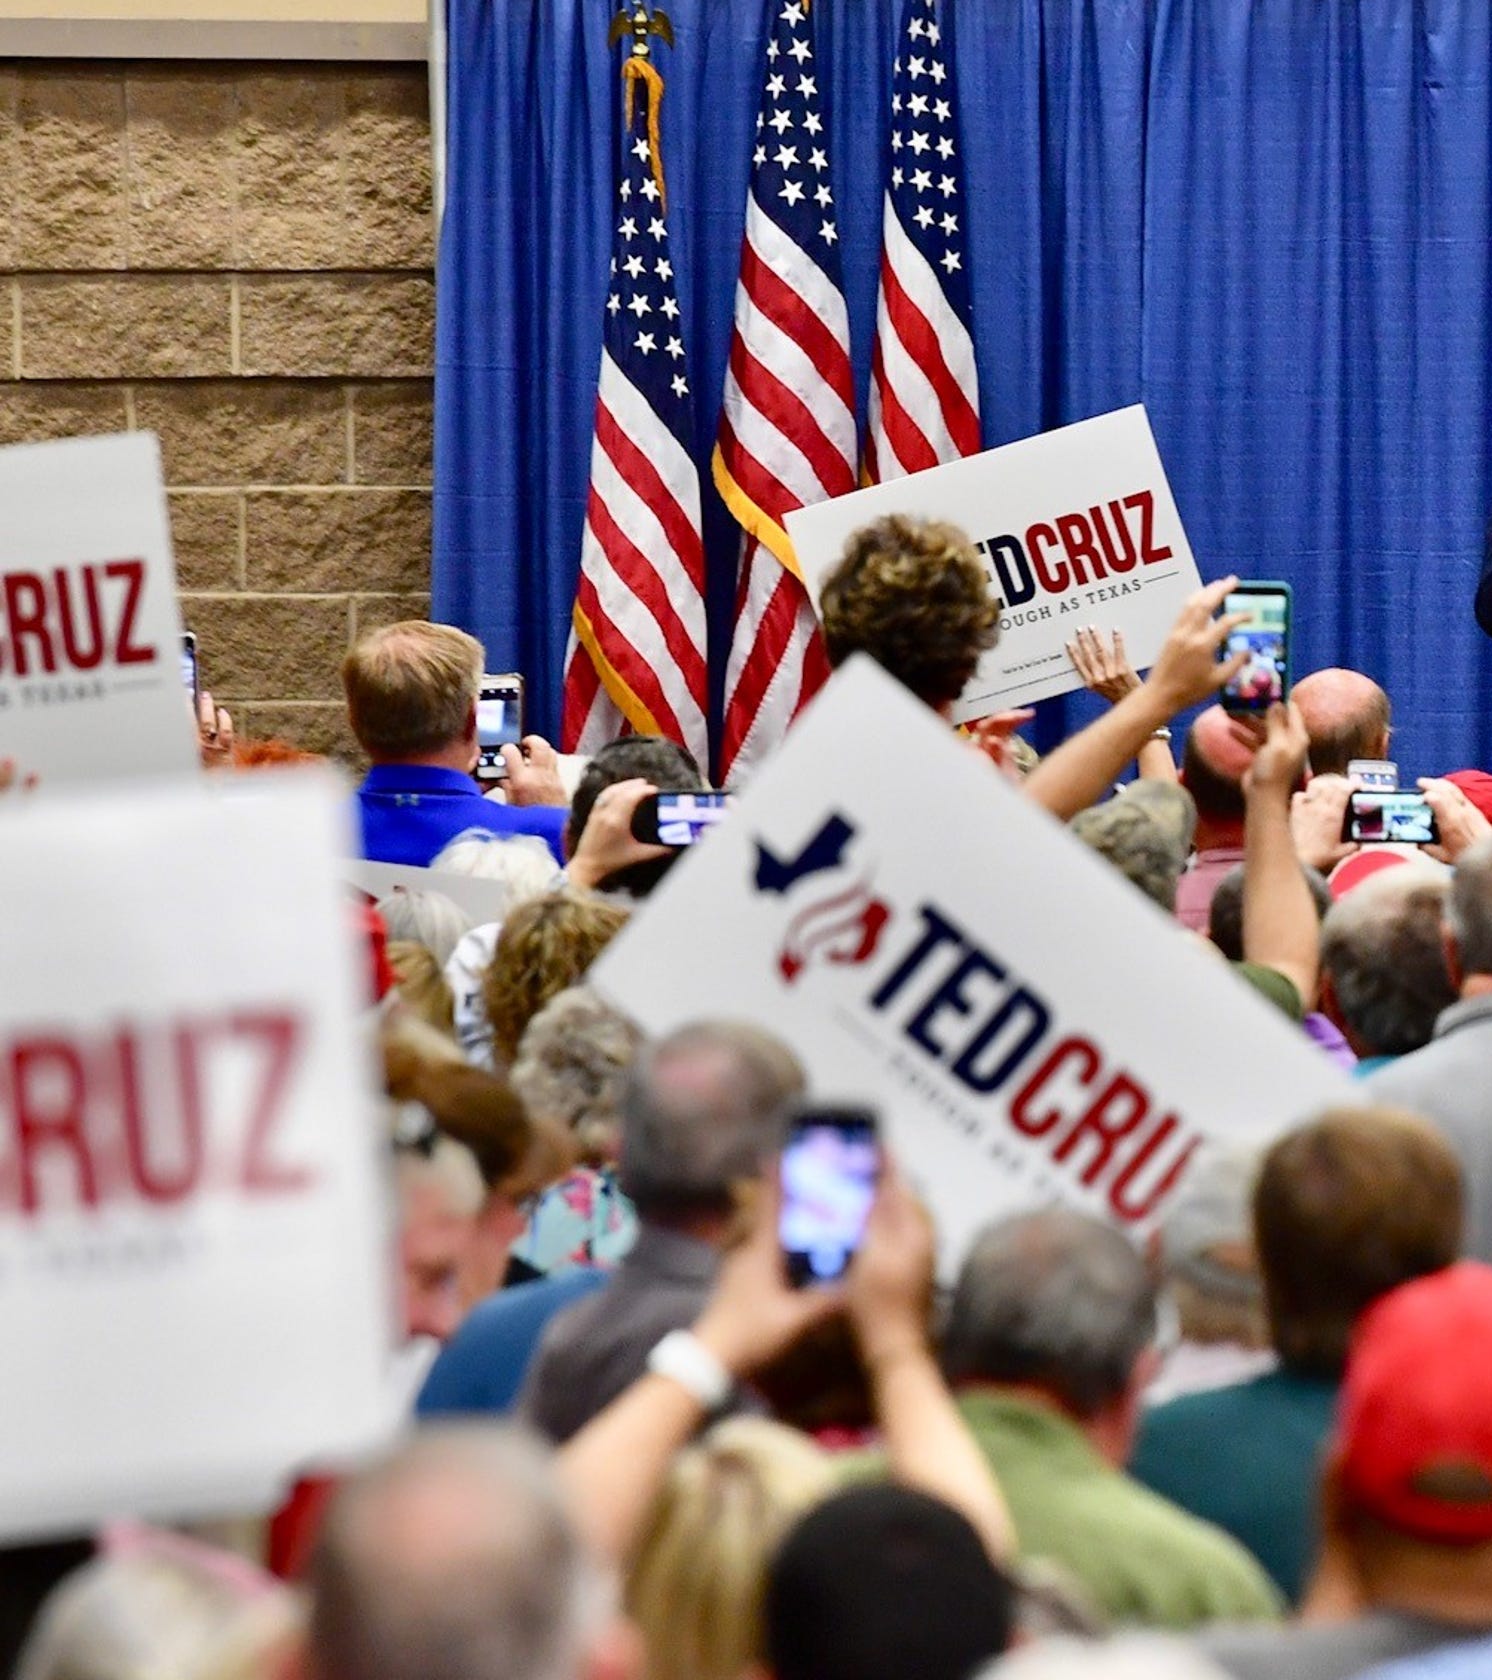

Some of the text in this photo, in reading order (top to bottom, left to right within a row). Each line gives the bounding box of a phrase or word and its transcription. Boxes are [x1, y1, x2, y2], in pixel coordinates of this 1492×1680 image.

[974, 489, 1173, 610] DCRUZ
[1000, 578, 1142, 631] OUGH AS TEXAS
[0, 559, 157, 676] RUZ
[0, 1008, 316, 1220] RUZ
[869, 901, 1204, 1238] TEDCRU
